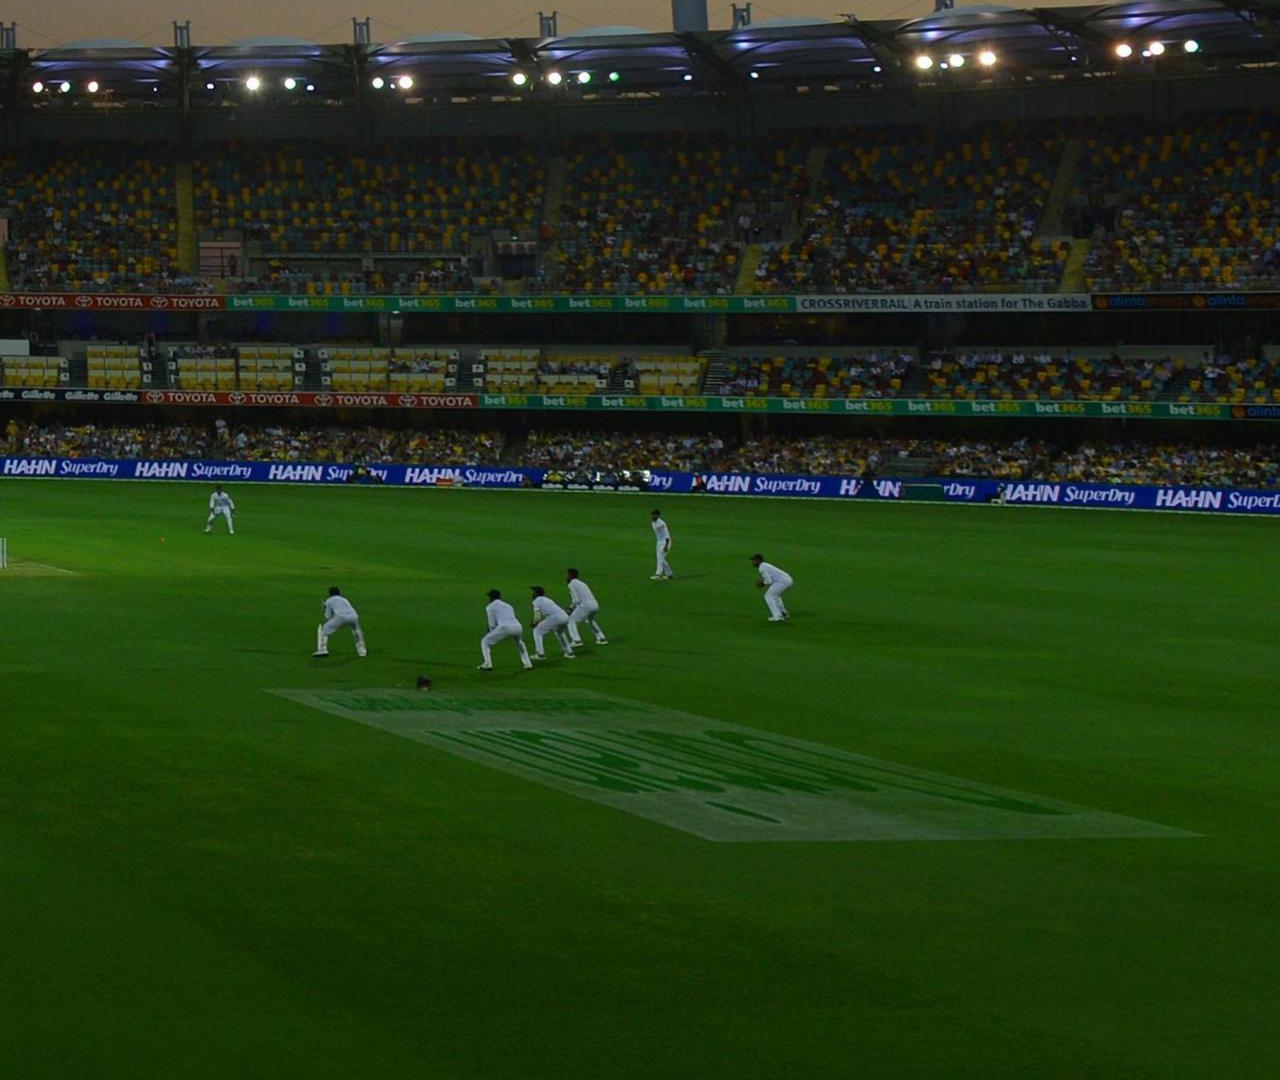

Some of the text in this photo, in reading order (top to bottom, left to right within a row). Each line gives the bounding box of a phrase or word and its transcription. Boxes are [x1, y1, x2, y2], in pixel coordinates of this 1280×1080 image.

[19, 295, 65, 306] TOYOTA
[96, 296, 142, 307] TOYOTA
[172, 297, 218, 308] TOYOTA
[913, 298, 921, 309] A
[925, 298, 949, 309] train
[954, 298, 996, 309] station
[1000, 298, 1017, 309] for
[1021, 298, 1043, 309] The
[1047, 298, 1087, 309] Gabba
[168, 392, 471, 407] TOYOTA TOYOTA TOYOTA TOYOTA
[1102, 404, 1152, 415] bet365
[1169, 405, 1221, 416] bet365
[3, 459, 56, 475] HAHN
[60, 460, 119, 477] SuperDry
[135, 461, 188, 478] HAHN
[191, 462, 251, 479] SuperDry
[269, 464, 323, 481] HAHN
[464, 469, 524, 486] SuperDr
[754, 477, 821, 494] SuperDry
[839, 478, 902, 497] HHN
[1064, 486, 1136, 506] SuperDry
[1155, 488, 1223, 510] HAHN
[1227, 492, 1280, 511] SuperD
